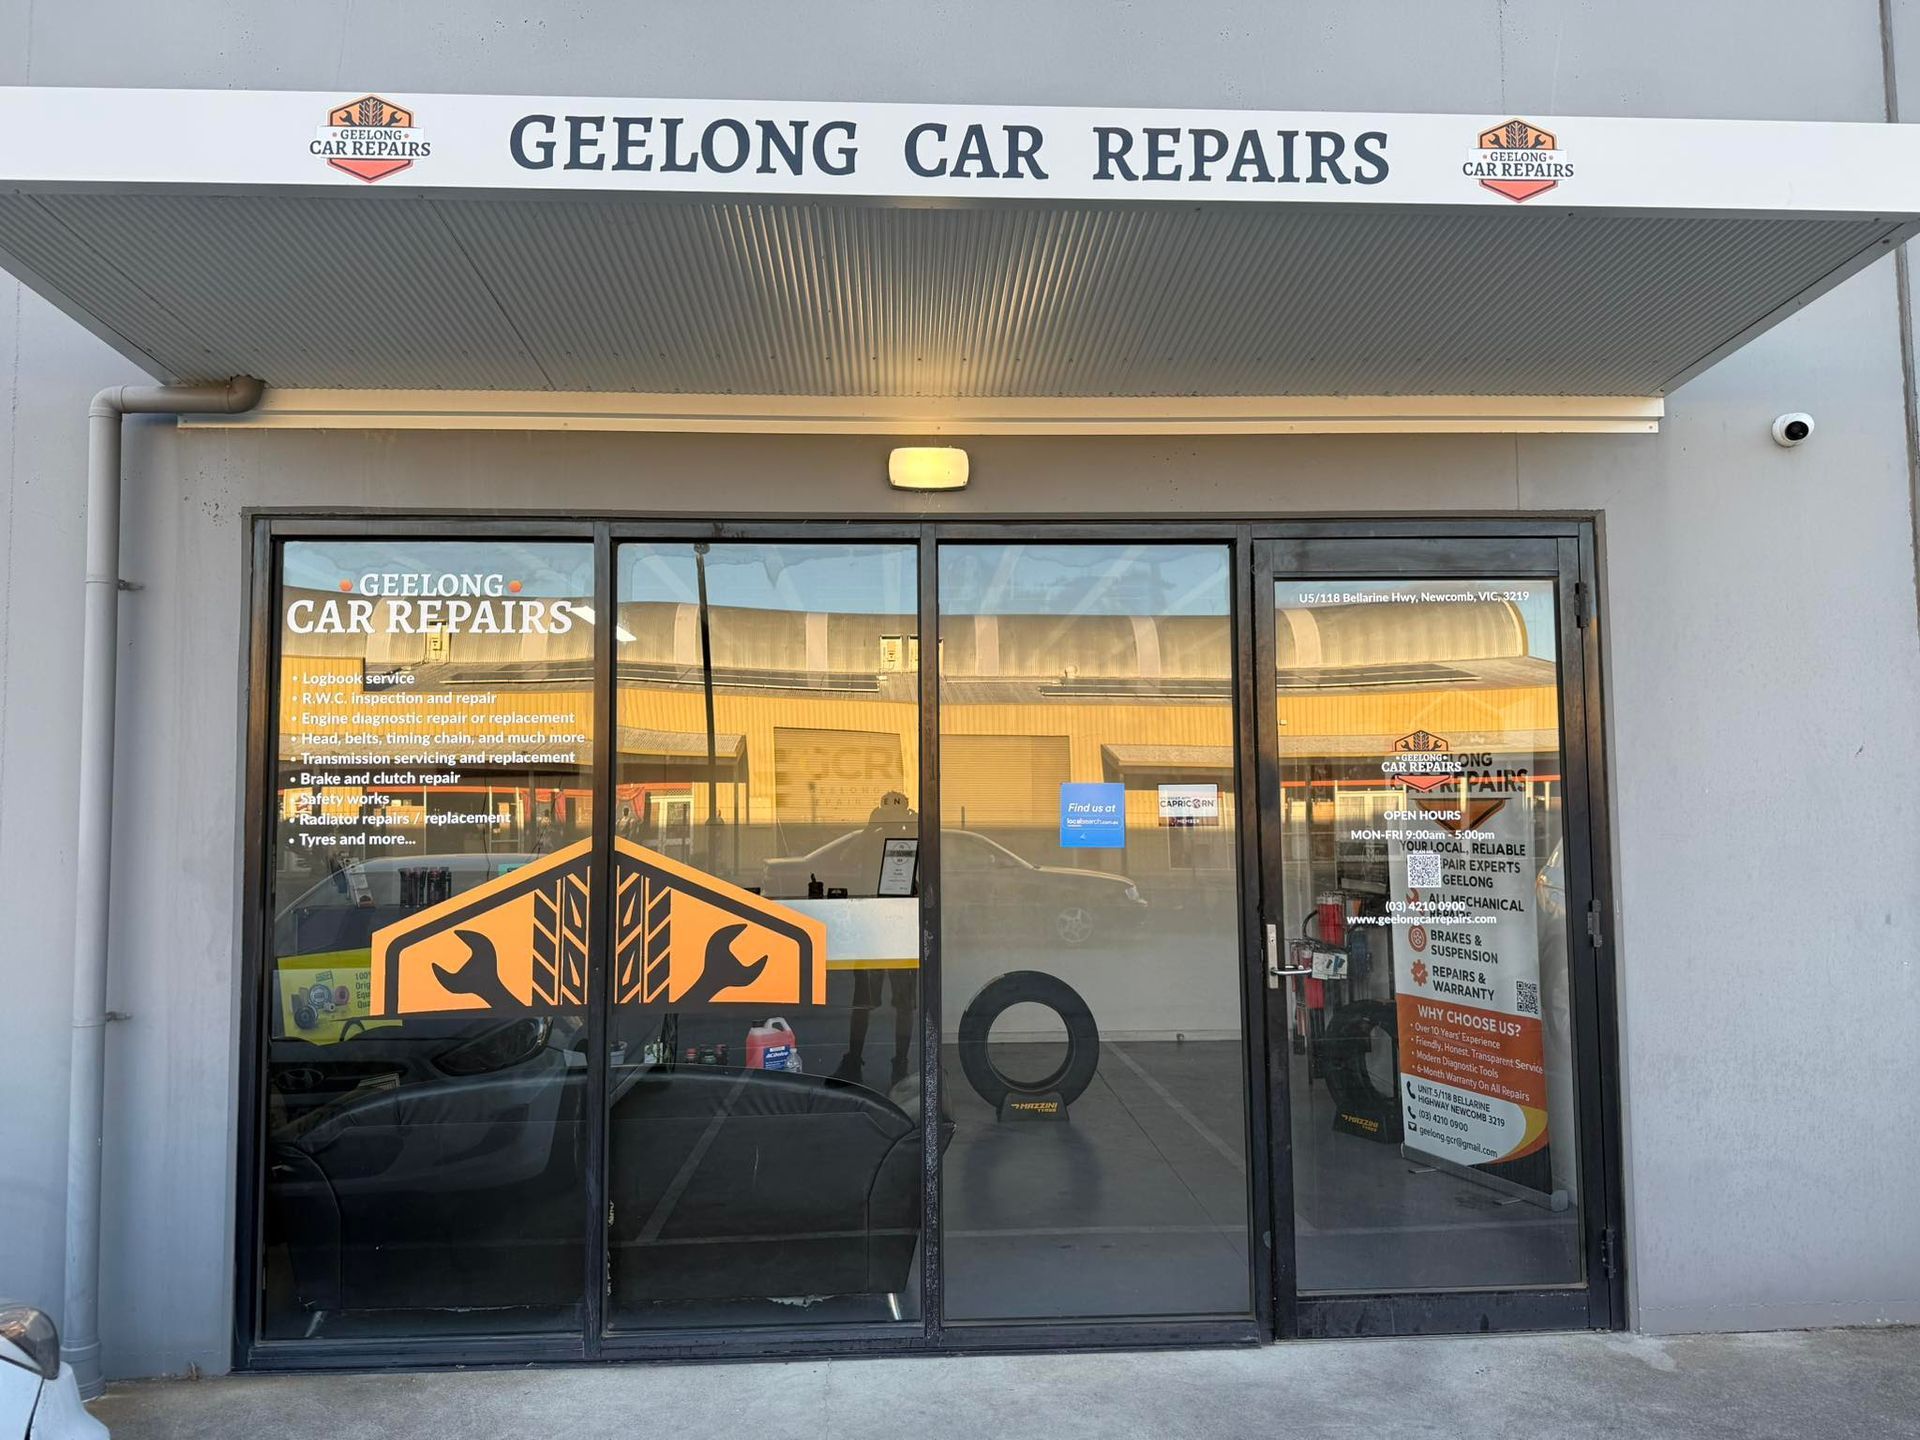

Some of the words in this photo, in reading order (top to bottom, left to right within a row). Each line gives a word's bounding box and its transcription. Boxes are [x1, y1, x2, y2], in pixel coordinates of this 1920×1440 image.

[340, 129, 402, 140] GEELONG
[310, 140, 348, 155] CAR
[352, 141, 431, 157] REPAIRS
[510, 114, 858, 176] GEELONG
[904, 123, 1049, 179] CAR
[1092, 126, 1389, 185] REPAIRS
[1490, 151, 1547, 162] GEELONG
[1463, 162, 1498, 176] CAR
[1501, 163, 1574, 177] REPAIRS
[359, 573, 504, 597] GEELONG
[1299, 593, 1340, 603] U5/118
[1343, 592, 1389, 603] Bellarine
[1391, 592, 1419, 604] Hwy,
[1421, 592, 1477, 604] Newcomb,
[1478, 591, 1502, 603] VIC,
[1503, 591, 1530, 601] 3219
[286, 600, 375, 634] CAR
[386, 600, 574, 634] REPAIRS
[303, 672, 363, 687] Logbook
[366, 672, 415, 684] service
[302, 692, 348, 704] R.W.C.
[352, 691, 423, 706] inspection
[427, 691, 453, 704] and
[456, 691, 497, 706] repair
[302, 712, 349, 726] Engine
[352, 711, 423, 726] diagnostic
[427, 711, 468, 725] repair
[471, 715, 488, 724] or
[489, 711, 576, 726] replacement
[301, 732, 341, 746] Head,
[345, 732, 383, 746] belts,
[387, 732, 431, 747] timing
[434, 731, 475, 745] chain,
[479, 731, 504, 744] and
[508, 731, 545, 744] much
[549, 733, 585, 744] more
[301, 752, 390, 765] Transmission
[394, 751, 457, 766] servicing
[460, 751, 485, 764] and
[489, 751, 576, 765] replacement
[1401, 753, 1442, 762] GEELONG
[1381, 762, 1407, 772] CAR
[1410, 761, 1462, 772] REPAIRS
[301, 772, 341, 785] Brake
[344, 772, 370, 784] and
[373, 771, 416, 784] clutch
[419, 771, 461, 785] repair
[300, 792, 343, 808] Safety
[347, 792, 390, 805] works
[1067, 803, 1090, 813] Find
[1091, 804, 1104, 813] us
[1104, 804, 1116, 813] at
[299, 812, 359, 826] Radiator
[362, 812, 409, 827] repairs
[425, 811, 511, 827] replacement
[1383, 810, 1417, 820] OPEN
[1419, 810, 1462, 820] HOURS
[299, 832, 336, 848] Tyres
[340, 832, 366, 845] and
[369, 835, 416, 845] more...
[1350, 829, 1403, 840] MON-FRI
[1405, 829, 1446, 840] 9:00am
[1454, 829, 1495, 842] 5:00pm
[1399, 840, 1428, 852] YOUR
[1472, 842, 1526, 857] RELIABLE
[1469, 859, 1521, 874] EXPERTS
[1442, 874, 1493, 888] GEELONG
[1385, 900, 1406, 913] (03)
[1408, 901, 1435, 911] 4210
[1438, 901, 1465, 911] 0900
[1346, 914, 1497, 926] www.geelongcarrepairs.com
[1430, 929, 1471, 946] BRAKES
[1474, 935, 1482, 946] &
[1431, 945, 1498, 964] SUSPENSION
[1432, 966, 1478, 982] REPAIRS
[1478, 973, 1486, 985] &
[356, 982, 371, 991] Orig
[1432, 980, 1495, 1001] WARRANTY
[357, 991, 371, 1000] Equ
[1417, 1004, 1443, 1021] WHY
[1446, 1011, 1497, 1032] CHOOSE
[1499, 1021, 1522, 1037] US?
[1415, 1023, 1430, 1033] Over
[1431, 1025, 1440, 1035] 10
[1462, 1032, 1501, 1050] Experience
[1416, 1050, 1441, 1065] Modern
[1443, 1055, 1478, 1074] Diagnostic
[1479, 1065, 1499, 1079] Tools
[1471, 1049, 1515, 1067] Transparent
[1515, 1060, 1544, 1075] Service
[1416, 1064, 1445, 1080] 6-Month
[1446, 1070, 1478, 1088] Warranty
[1478, 1080, 1490, 1091] On
[1490, 1082, 1501, 1093] All
[1502, 1085, 1530, 1102] Repairs
[1452, 1092, 1491, 1113] BELLARINE
[1418, 1095, 1450, 1112] HIGHWAY
[1451, 1104, 1487, 1122] NEWCOMB
[1488, 1115, 1505, 1128] 3219
[1418, 1109, 1432, 1122] (03)
[1432, 1113, 1449, 1126] 4210
[1449, 1119, 1469, 1133] 0900
